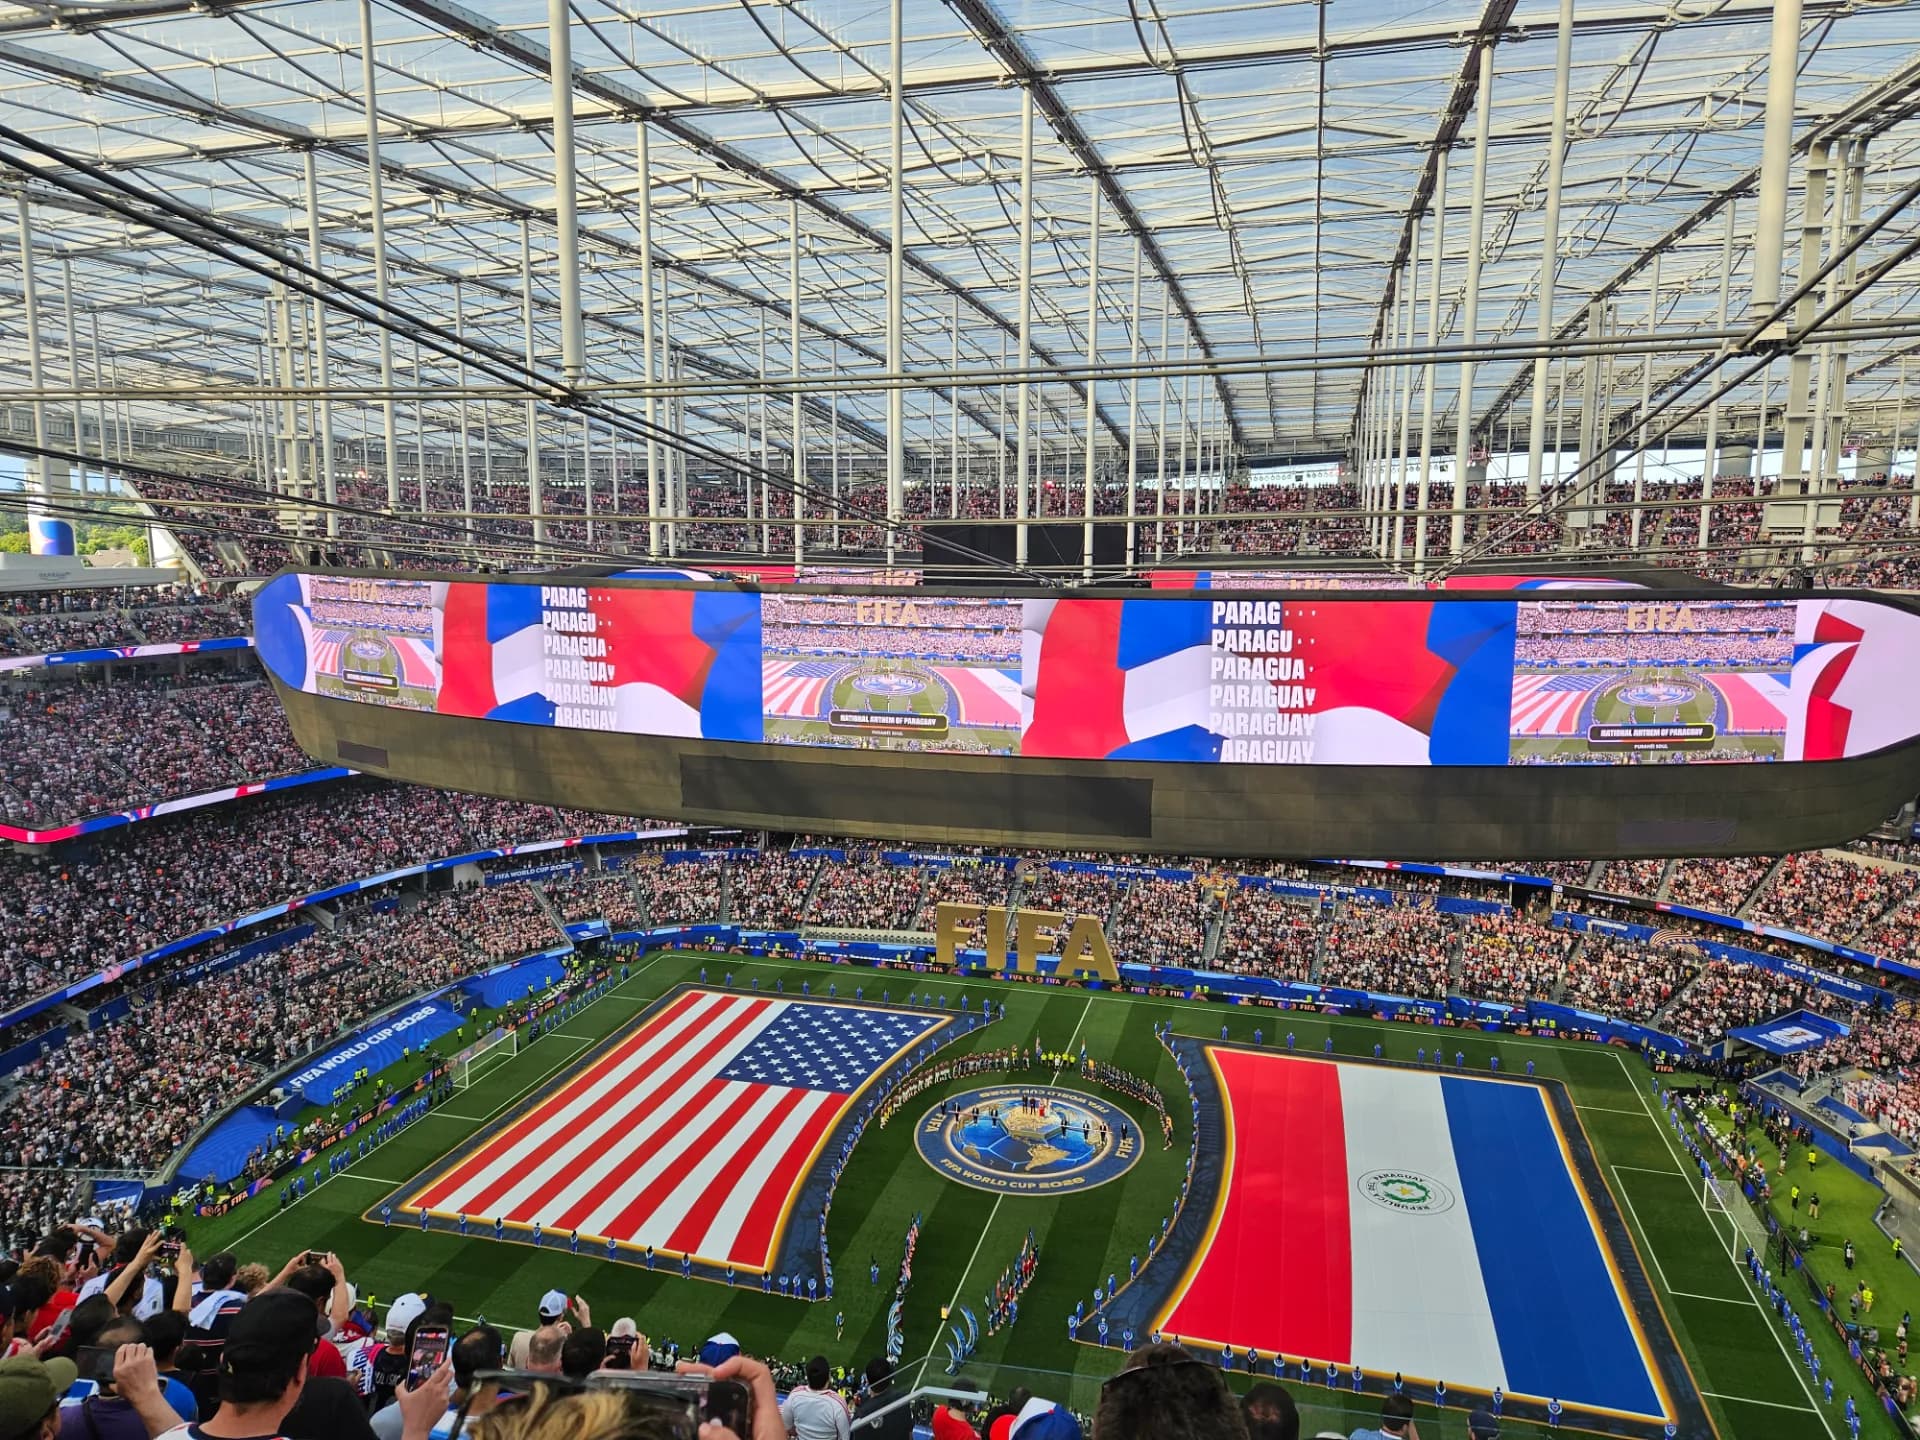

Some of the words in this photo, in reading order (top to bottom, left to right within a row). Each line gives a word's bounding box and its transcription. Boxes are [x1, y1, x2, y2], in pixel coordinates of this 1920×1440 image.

[542, 586, 588, 608] PARAG
[857, 601, 920, 624] FIFA
[1212, 601, 1281, 625] PARAG
[1628, 607, 1694, 632] FIFA
[543, 611, 596, 632] PARAGU
[544, 635, 606, 657] PARAGUA
[1211, 629, 1293, 653] PARAGU
[545, 659, 615, 682] PARAGUAY
[1210, 657, 1305, 681] PARAGUA
[546, 682, 616, 707] PARAGUAY
[1209, 684, 1316, 708] PARAGUAY
[1208, 712, 1316, 736] PARAGUAY
[1600, 729, 1632, 737] NATIONAL
[1633, 728, 1660, 737] ANTHEM
[1660, 728, 1668, 737] OF
[1669, 728, 1704, 737] PARAGUAY
[511, 868, 536, 878] WORLD
[536, 866, 549, 874] CUP
[550, 862, 573, 872] 2026
[1288, 881, 1314, 889] WORLD
[936, 901, 1120, 981] FIFA
[929, 965, 943, 973] FIFA
[1783, 961, 1806, 973] LOS
[1808, 970, 1862, 991] ANGELES
[1045, 977, 1061, 985] FIFA
[1130, 986, 1146, 994] FIFA
[1169, 990, 1185, 998] FIFA
[1258, 999, 1274, 1007] FIFA
[1300, 1003, 1316, 1012] FIFA
[1394, 1014, 1411, 1022] FIFA
[1438, 1019, 1455, 1027] FIFA
[1538, 1029, 1556, 1037] FIFA
[1584, 1034, 1602, 1042] FIFA
[289, 1069, 325, 1089] FIFA
[319, 1042, 370, 1070] WORLD
[366, 1028, 394, 1045] CUP
[391, 1005, 438, 1032] 2026
[1655, 1065, 1674, 1073] FIFA
[1046, 1090, 1087, 1104] WORLD
[358, 1112, 373, 1125] FIFA
[321, 1134, 337, 1149] FIFA
[1115, 1137, 1134, 1158] FIFA
[940, 1157, 962, 1173] FIFA
[962, 1169, 1007, 1187] WORLD
[1009, 1182, 1036, 1190] CUP
[1039, 1176, 1086, 1189] 2026
[230, 1190, 248, 1206] FIFA
